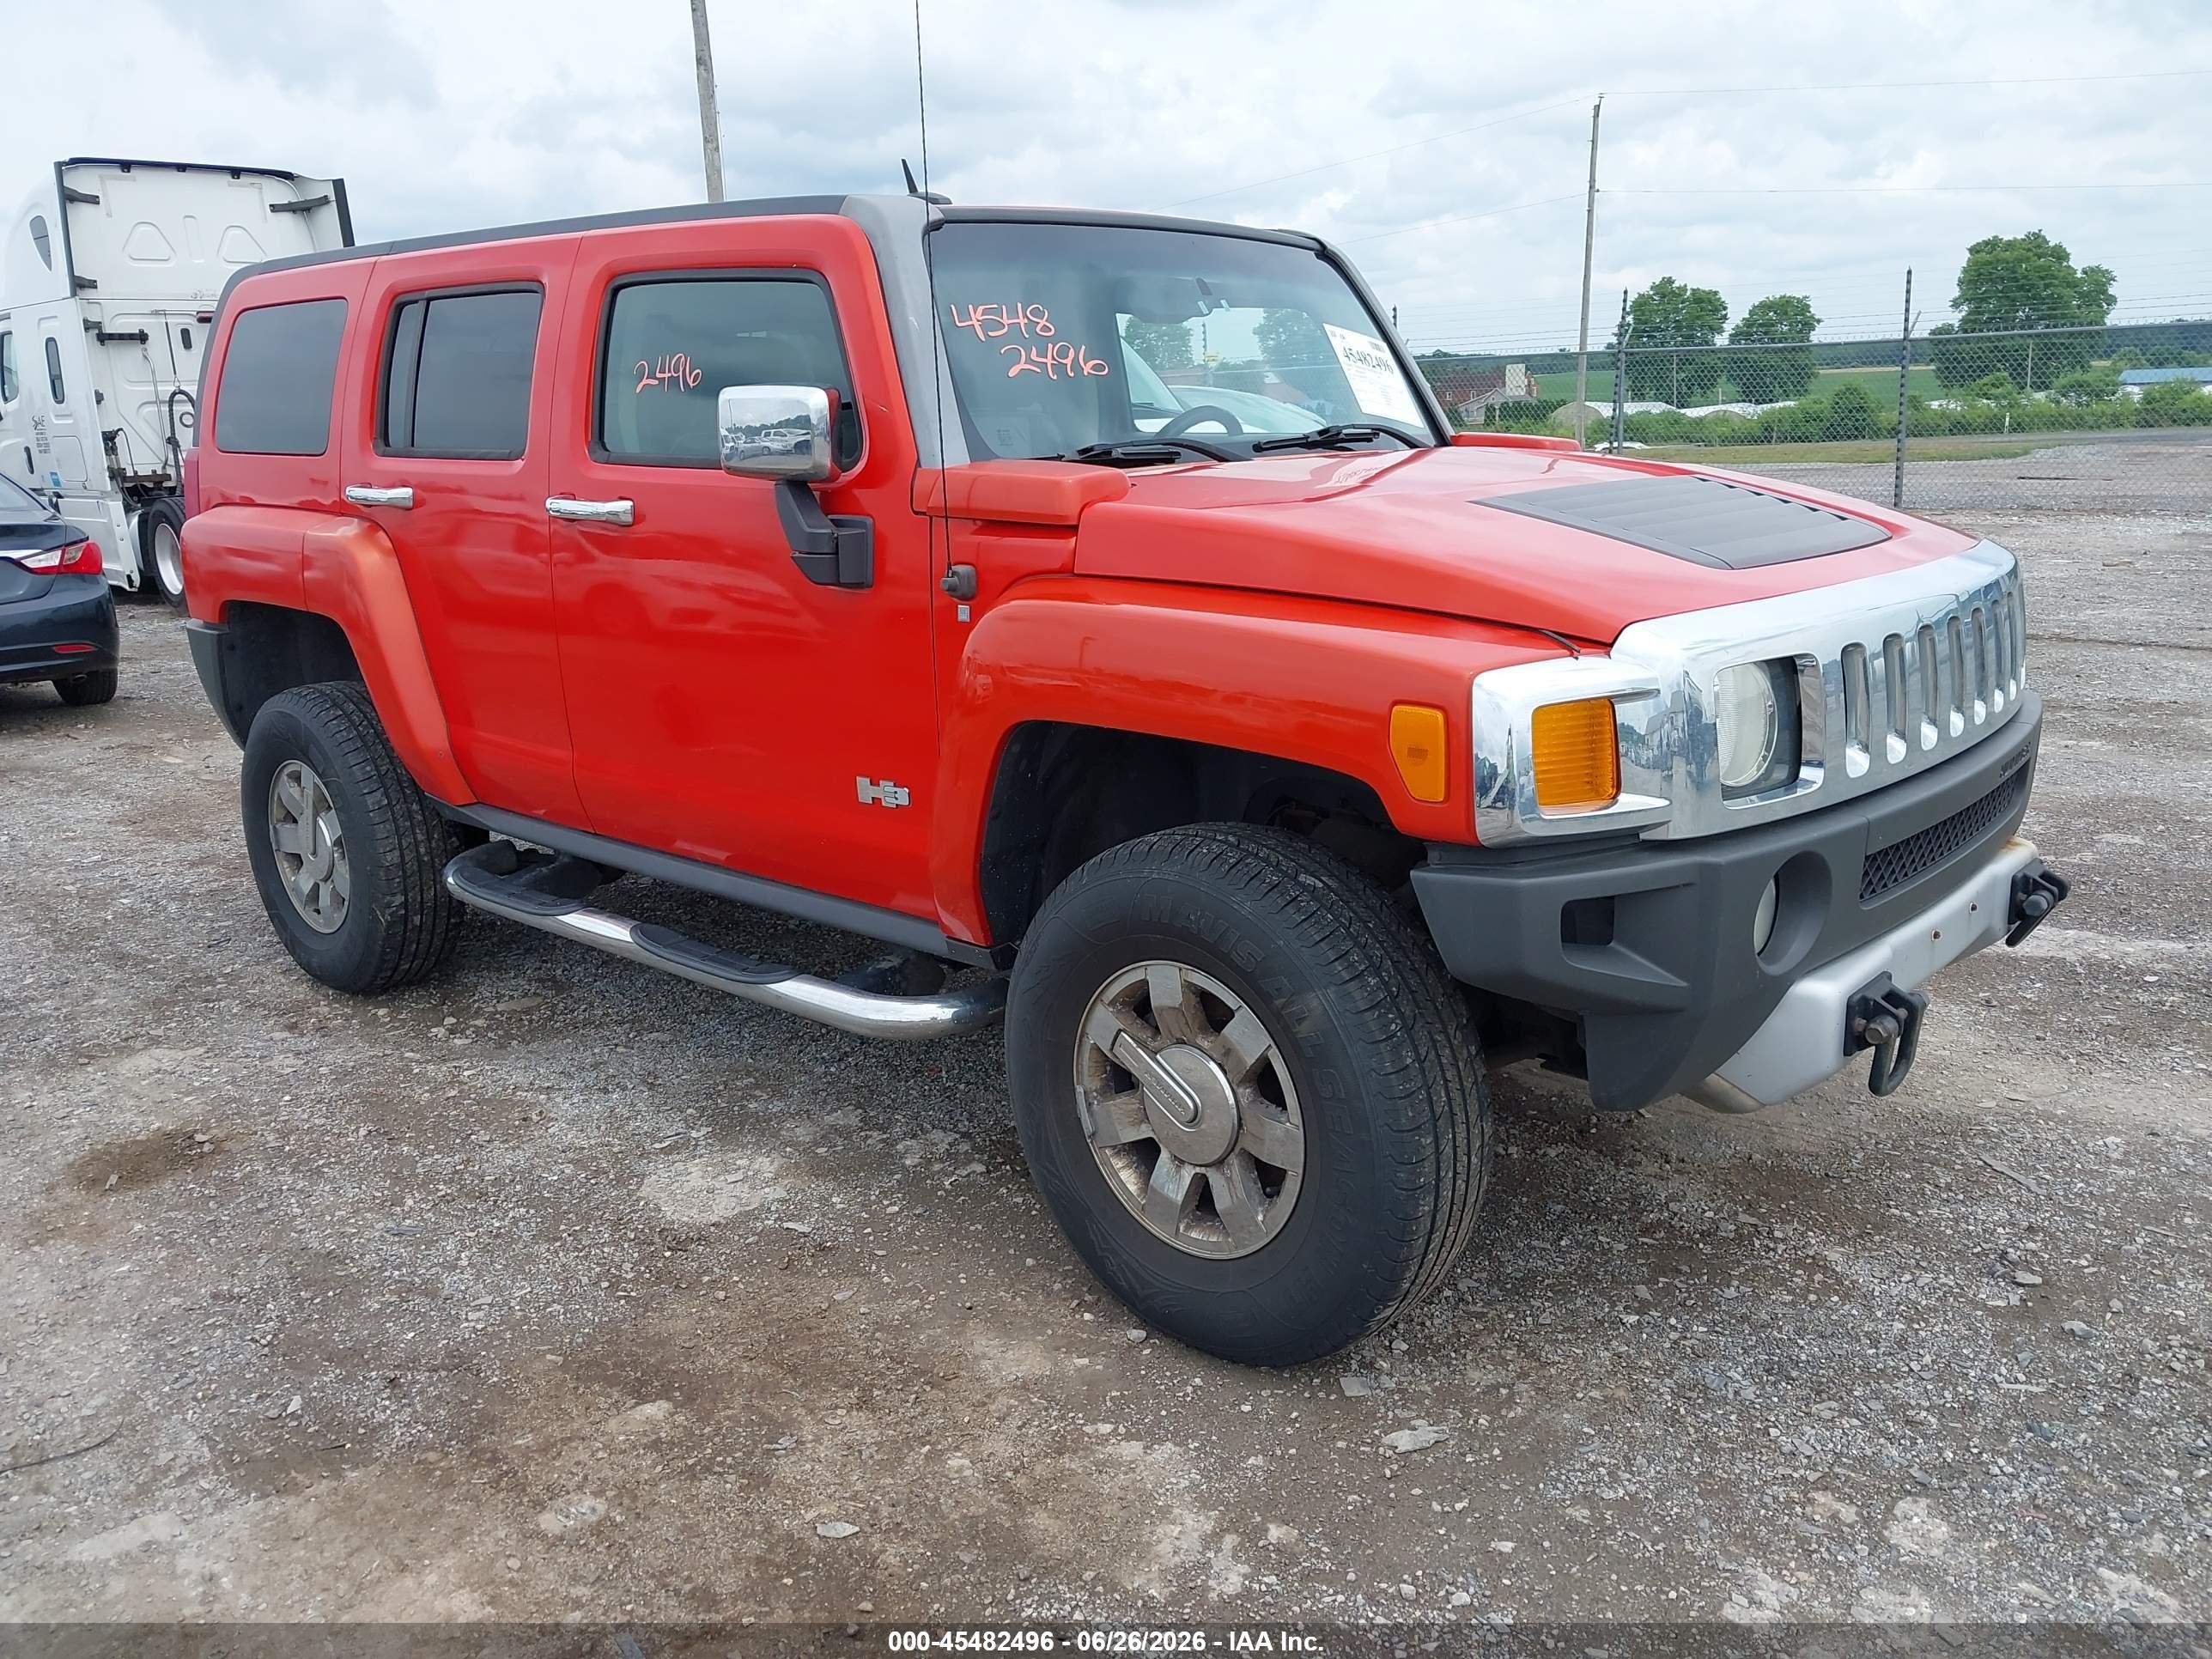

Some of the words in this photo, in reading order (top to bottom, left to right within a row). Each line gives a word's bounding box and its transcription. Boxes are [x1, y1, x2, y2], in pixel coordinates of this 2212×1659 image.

[951, 302, 1054, 342] 4548
[633, 353, 702, 393] 2496
[1000, 342, 1109, 380] 2496
[1342, 346, 1395, 374] 45482496
[856, 775, 910, 809] H3
